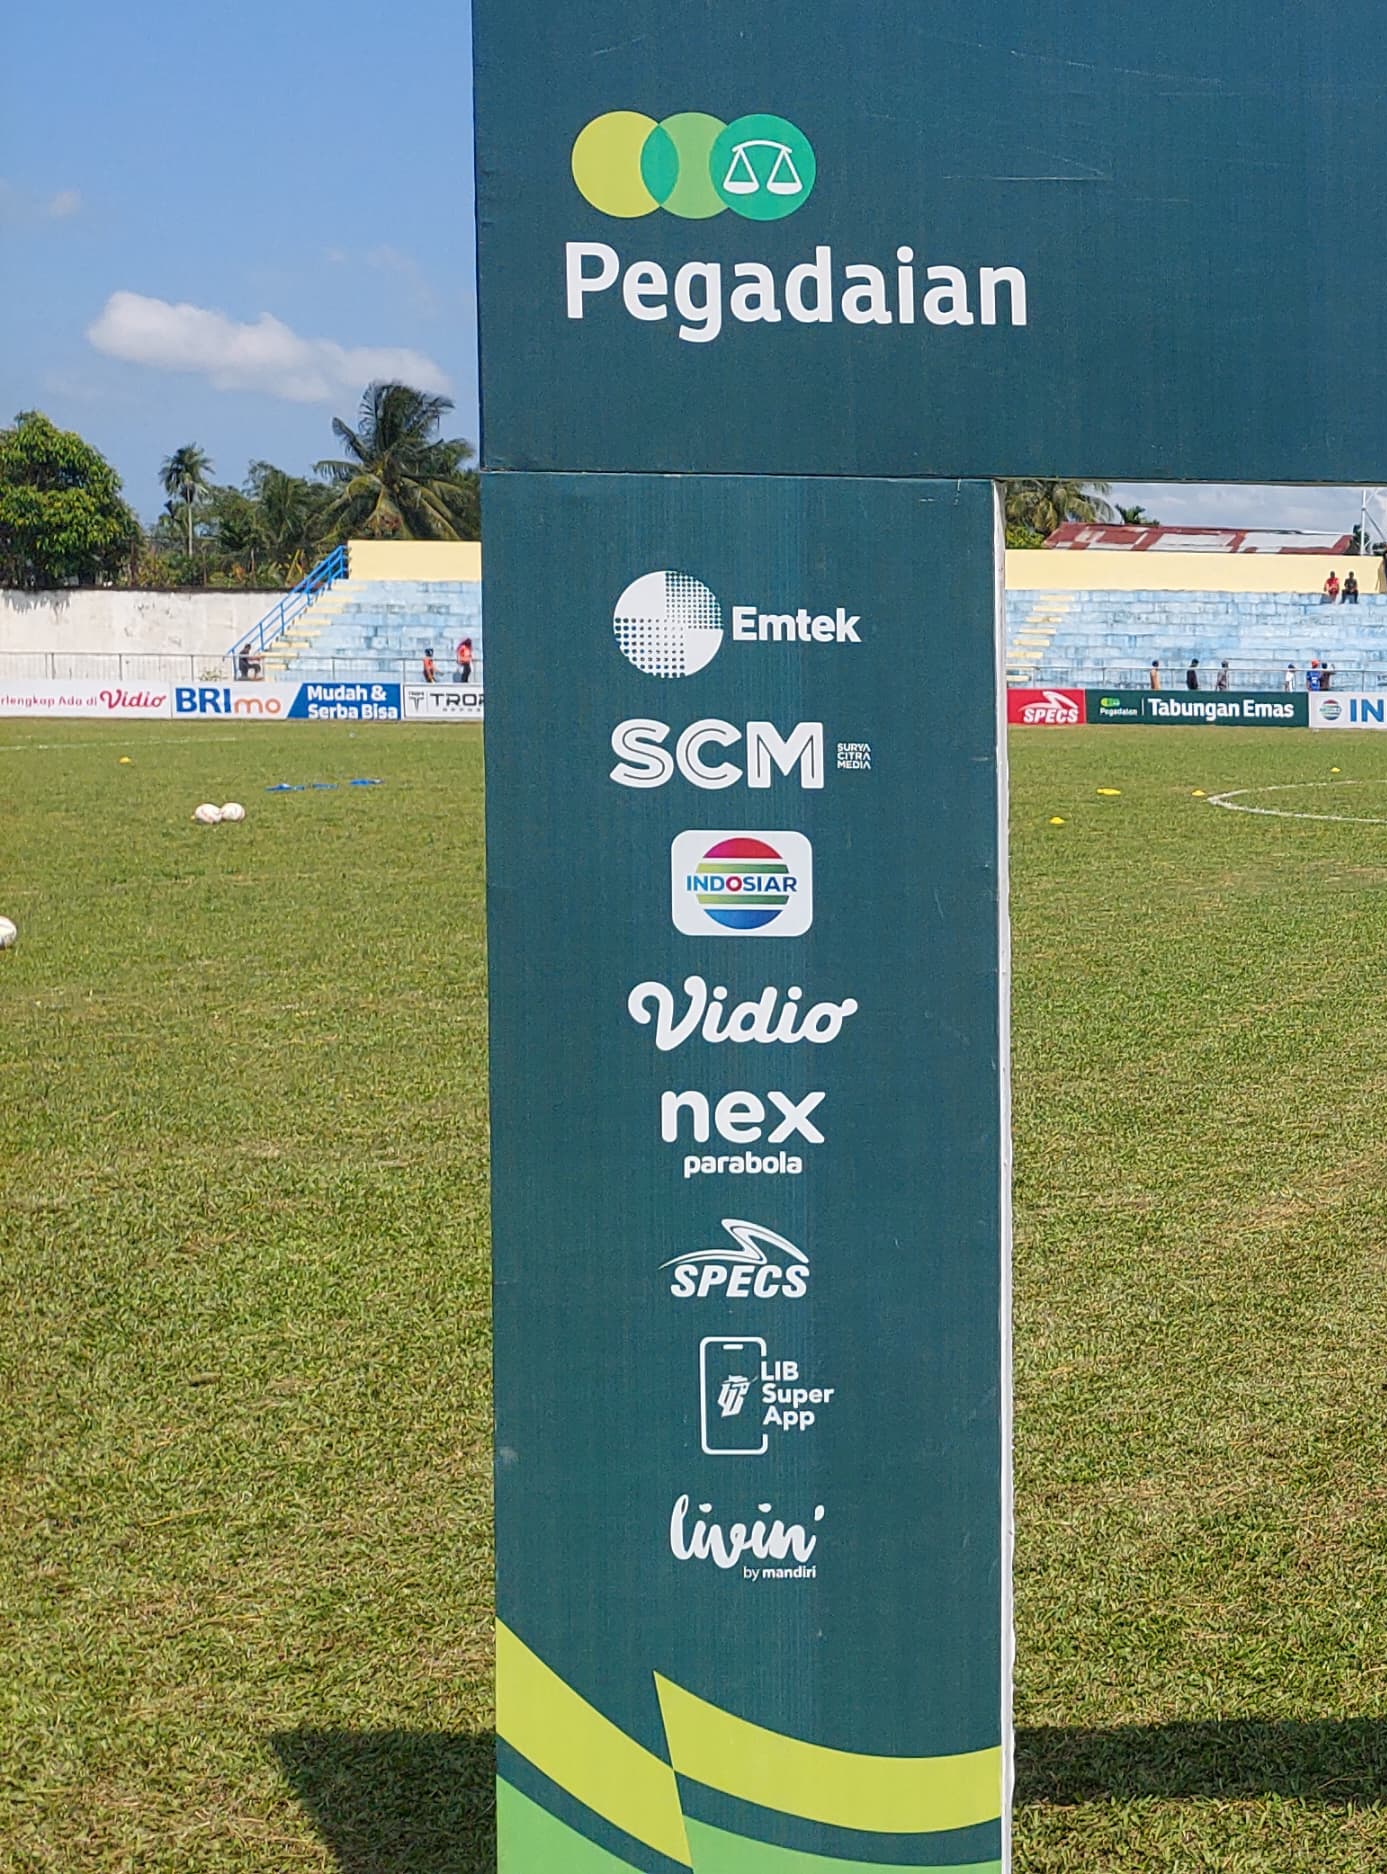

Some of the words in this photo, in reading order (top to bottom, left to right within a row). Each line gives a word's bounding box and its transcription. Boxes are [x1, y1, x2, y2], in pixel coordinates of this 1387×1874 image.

[565, 241, 1028, 343] Pegadaian
[732, 606, 862, 643] Emtek
[58, 695, 82, 706] Ada
[86, 695, 97, 706] di
[99, 688, 166, 709] Vidio
[175, 687, 281, 714] BRImo
[307, 684, 368, 701] Mudah
[371, 684, 387, 701] &
[308, 703, 359, 719] Serba
[361, 703, 398, 719] Bisa
[1022, 707, 1079, 724] SPECS
[1147, 698, 1240, 722] Tabungan
[1243, 699, 1294, 718] Emas
[609, 718, 825, 790] SCM
[837, 742, 871, 752] SURYA
[837, 751, 871, 760] CITRA
[837, 760, 871, 770] MEDIA
[686, 874, 798, 894] INDOSIAR
[627, 974, 859, 1052] Vidio
[660, 1090, 826, 1144] nex
[683, 1151, 803, 1179] parabola
[670, 1264, 811, 1298] SPECS
[760, 1360, 799, 1381] LIB
[762, 1382, 835, 1409] Super
[762, 1405, 816, 1431] App
[670, 1493, 825, 1569] livin'
[743, 1566, 760, 1582] by
[762, 1565, 817, 1579] mandiri
